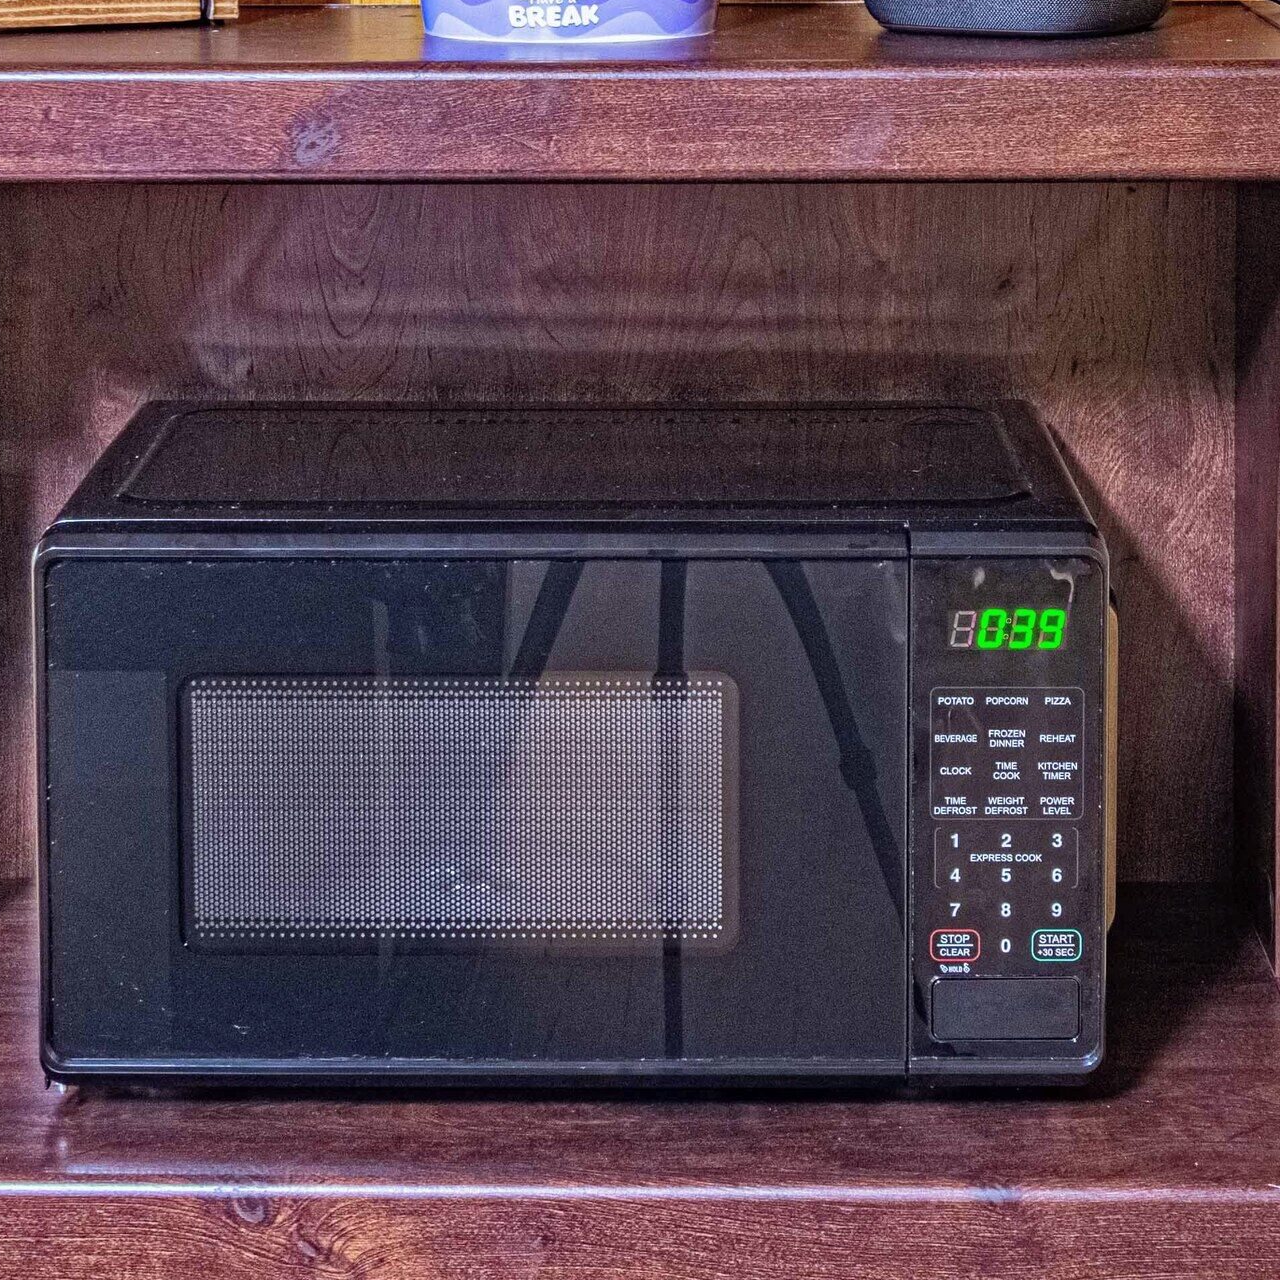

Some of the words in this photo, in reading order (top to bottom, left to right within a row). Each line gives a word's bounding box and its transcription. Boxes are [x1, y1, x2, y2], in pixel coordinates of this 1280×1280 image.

[508, 4, 600, 28] BREAK
[937, 696, 975, 706] POTATO
[985, 696, 1029, 706] POPCORN
[1044, 696, 1072, 706] PIZZA
[934, 734, 978, 743] BEVERAGE
[988, 729, 1026, 739] FROZEN
[1039, 734, 1077, 743] REHEAT
[989, 739, 1025, 748] DINNER
[939, 766, 972, 776] CLOCK
[995, 761, 1018, 771] TIME
[1037, 761, 1078, 771] KITCHEN
[992, 771, 1021, 781] COOK
[1042, 771, 1072, 781] TIMER
[944, 796, 967, 806] TIME
[987, 796, 1026, 806] WEIGHT
[1039, 796, 1075, 806] POWER
[933, 806, 978, 816] DEFROST
[984, 806, 1029, 816] DEFROST
[1042, 806, 1072, 816] LEVEL
[950, 833, 960, 848] 1
[1000, 833, 1012, 848] 2
[1051, 833, 1063, 848] 3
[969, 853, 1014, 863] EXPRESS
[1014, 853, 1043, 863] COOK
[949, 867, 962, 883] 4
[1000, 867, 1012, 883] 5
[1051, 867, 1063, 883] 6
[949, 902, 961, 918] 7
[1000, 902, 1012, 918] 8
[1051, 902, 1063, 918] 9
[940, 934, 971, 944] STOP
[1038, 934, 1075, 944] START
[1000, 938, 1012, 954] 0
[939, 947, 971, 957] CLEAR
[1037, 947, 1054, 957] +30
[1054, 947, 1077, 957] SEC.
